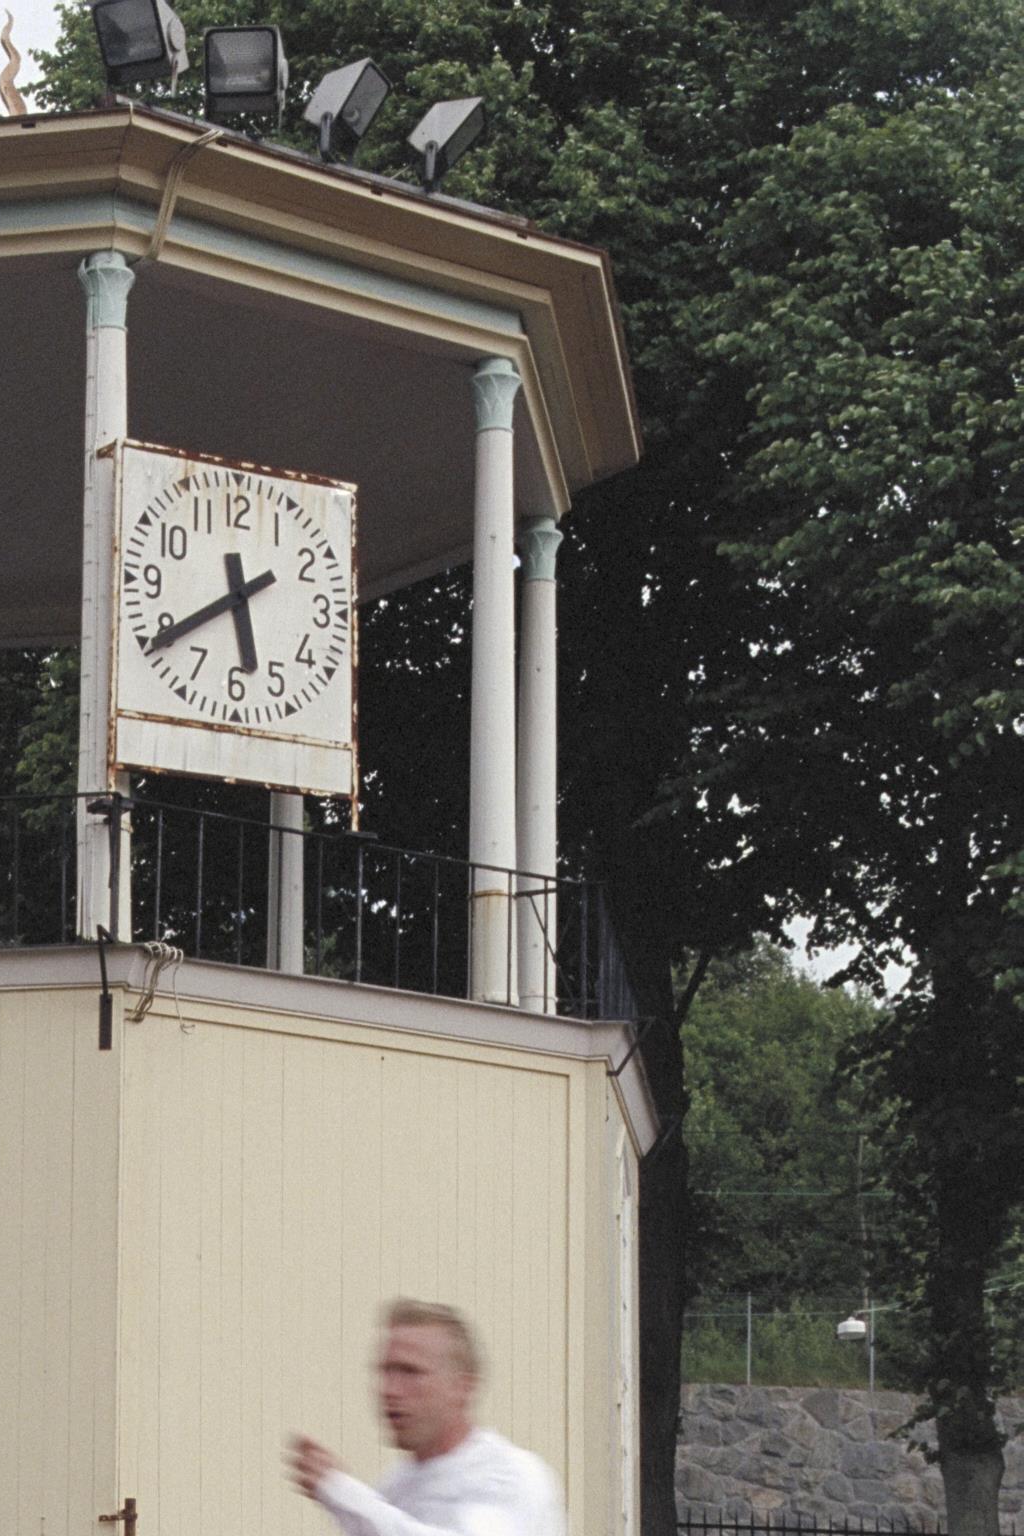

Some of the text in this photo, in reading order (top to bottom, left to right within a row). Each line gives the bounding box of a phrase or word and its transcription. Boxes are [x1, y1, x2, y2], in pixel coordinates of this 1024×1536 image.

[193, 496, 212, 535] 11
[226, 492, 251, 531] 12
[273, 512, 280, 547] 1
[160, 522, 187, 561] 10
[143, 564, 162, 600] 9
[298, 547, 317, 583] 2
[312, 594, 331, 629] 3
[189, 646, 208, 681] 7
[295, 633, 317, 669] 4
[228, 666, 246, 702] 6
[267, 660, 285, 698] 5
